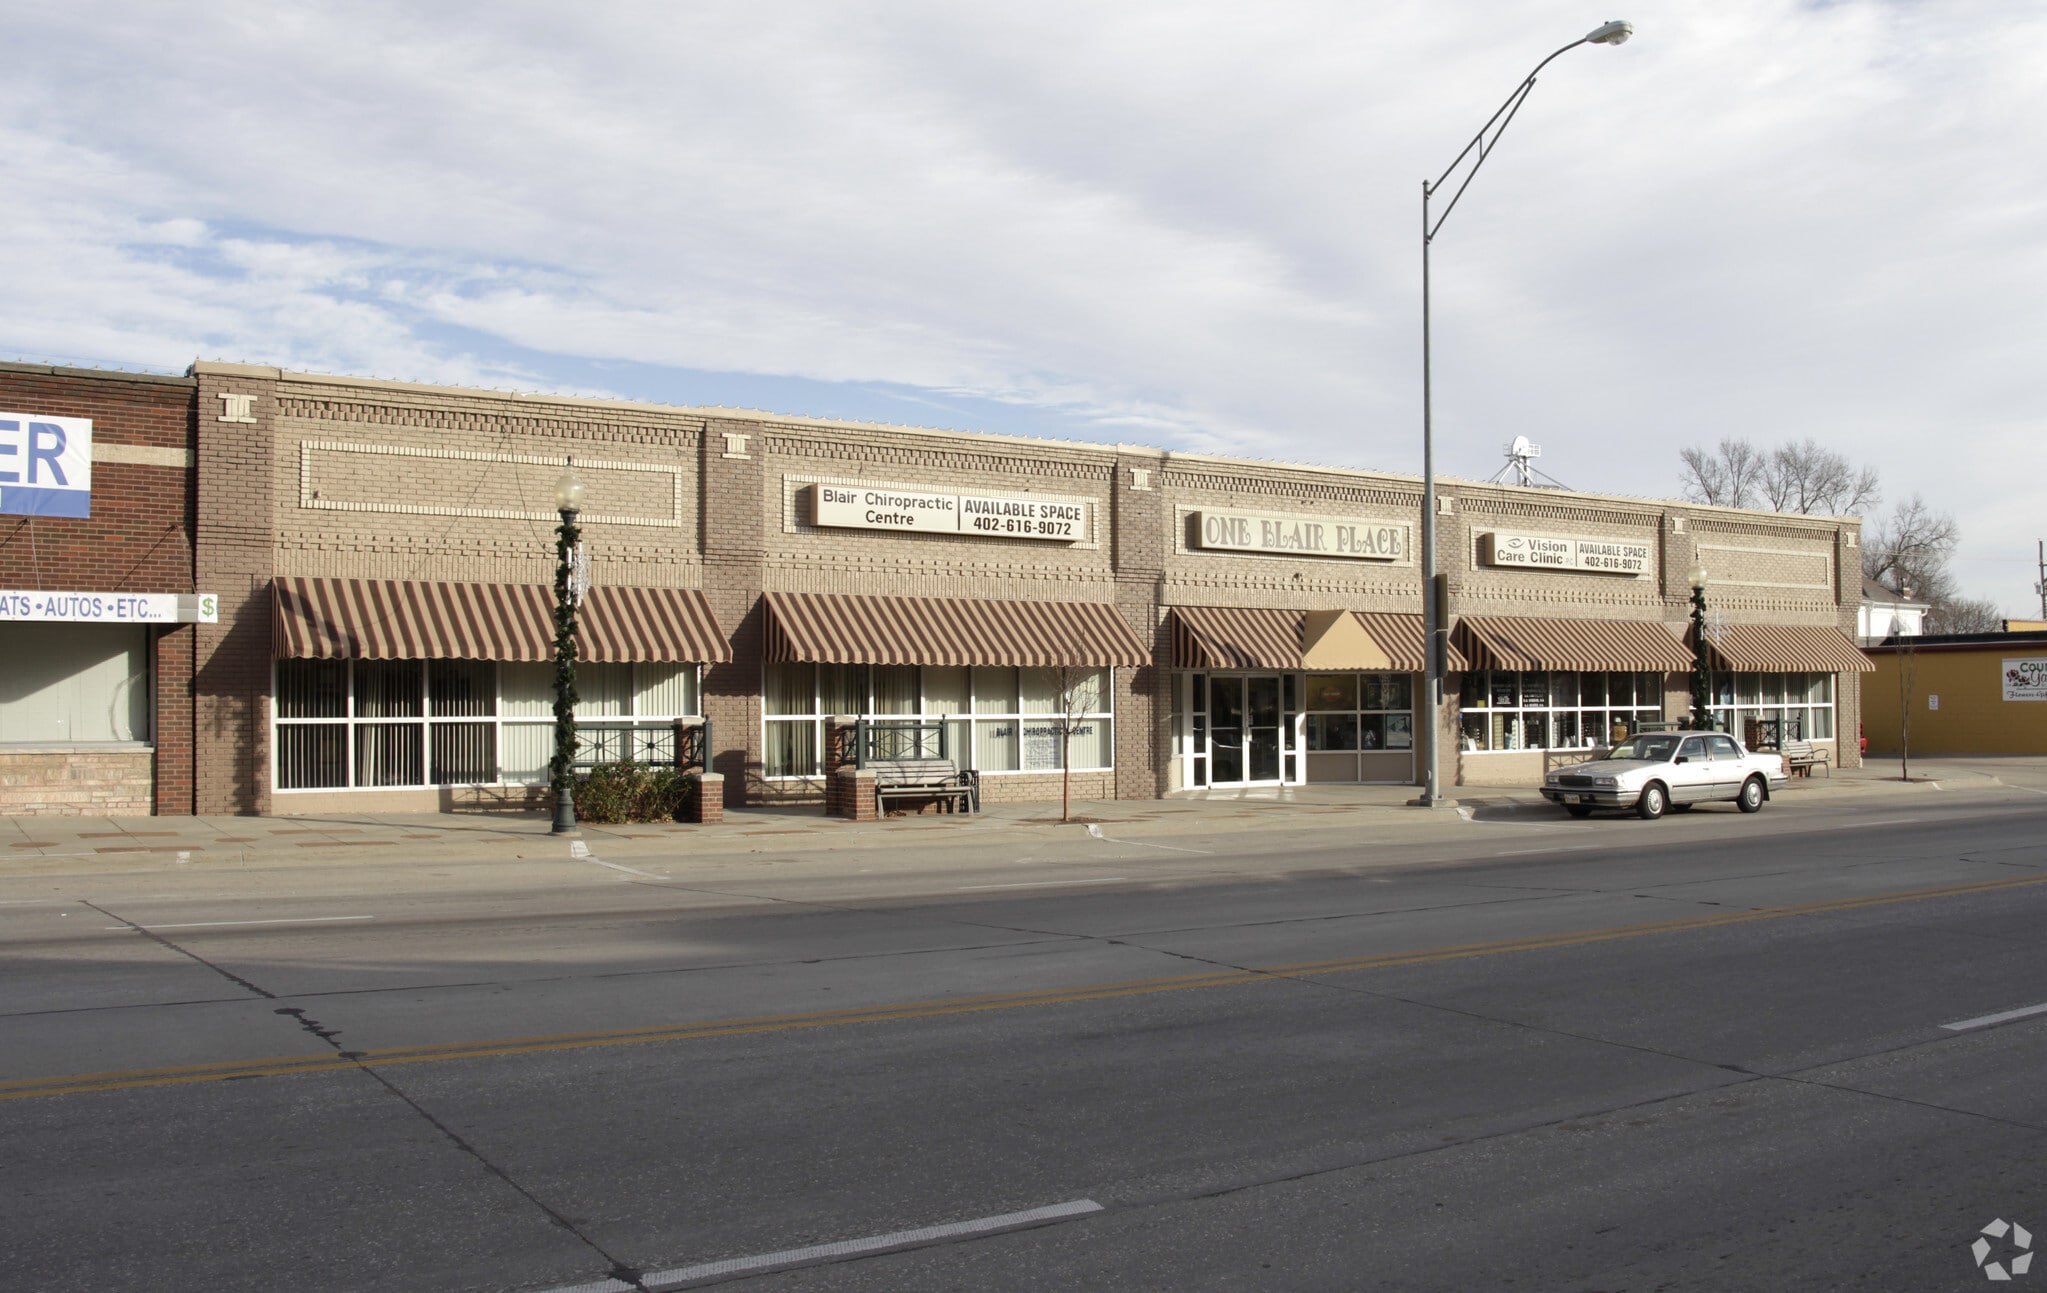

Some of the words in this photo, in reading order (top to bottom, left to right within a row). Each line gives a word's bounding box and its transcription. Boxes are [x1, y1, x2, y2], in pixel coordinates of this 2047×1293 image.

[823, 489, 857, 504] Blair
[865, 492, 953, 510] Chiropractic
[866, 510, 914, 525] Centre
[964, 499, 1035, 518] AVAILABLE
[1040, 504, 1081, 521] SPACE
[973, 516, 1072, 536] 402-616-9072
[1205, 515, 1251, 546] ONE
[1260, 519, 1328, 551] BLAIR
[1336, 524, 1401, 556] PLACE
[1527, 538, 1568, 553] Vision
[1578, 542, 1621, 557] AVAILABLE
[1623, 547, 1648, 559] SPACE
[1497, 549, 1525, 562] Care
[1530, 551, 1564, 565] Clinic
[1584, 555, 1643, 571] 402-616-9072
[0, 594, 31, 616] ATS
[44, 596, 103, 618] AUTOS
[202, 597, 215, 617] $
